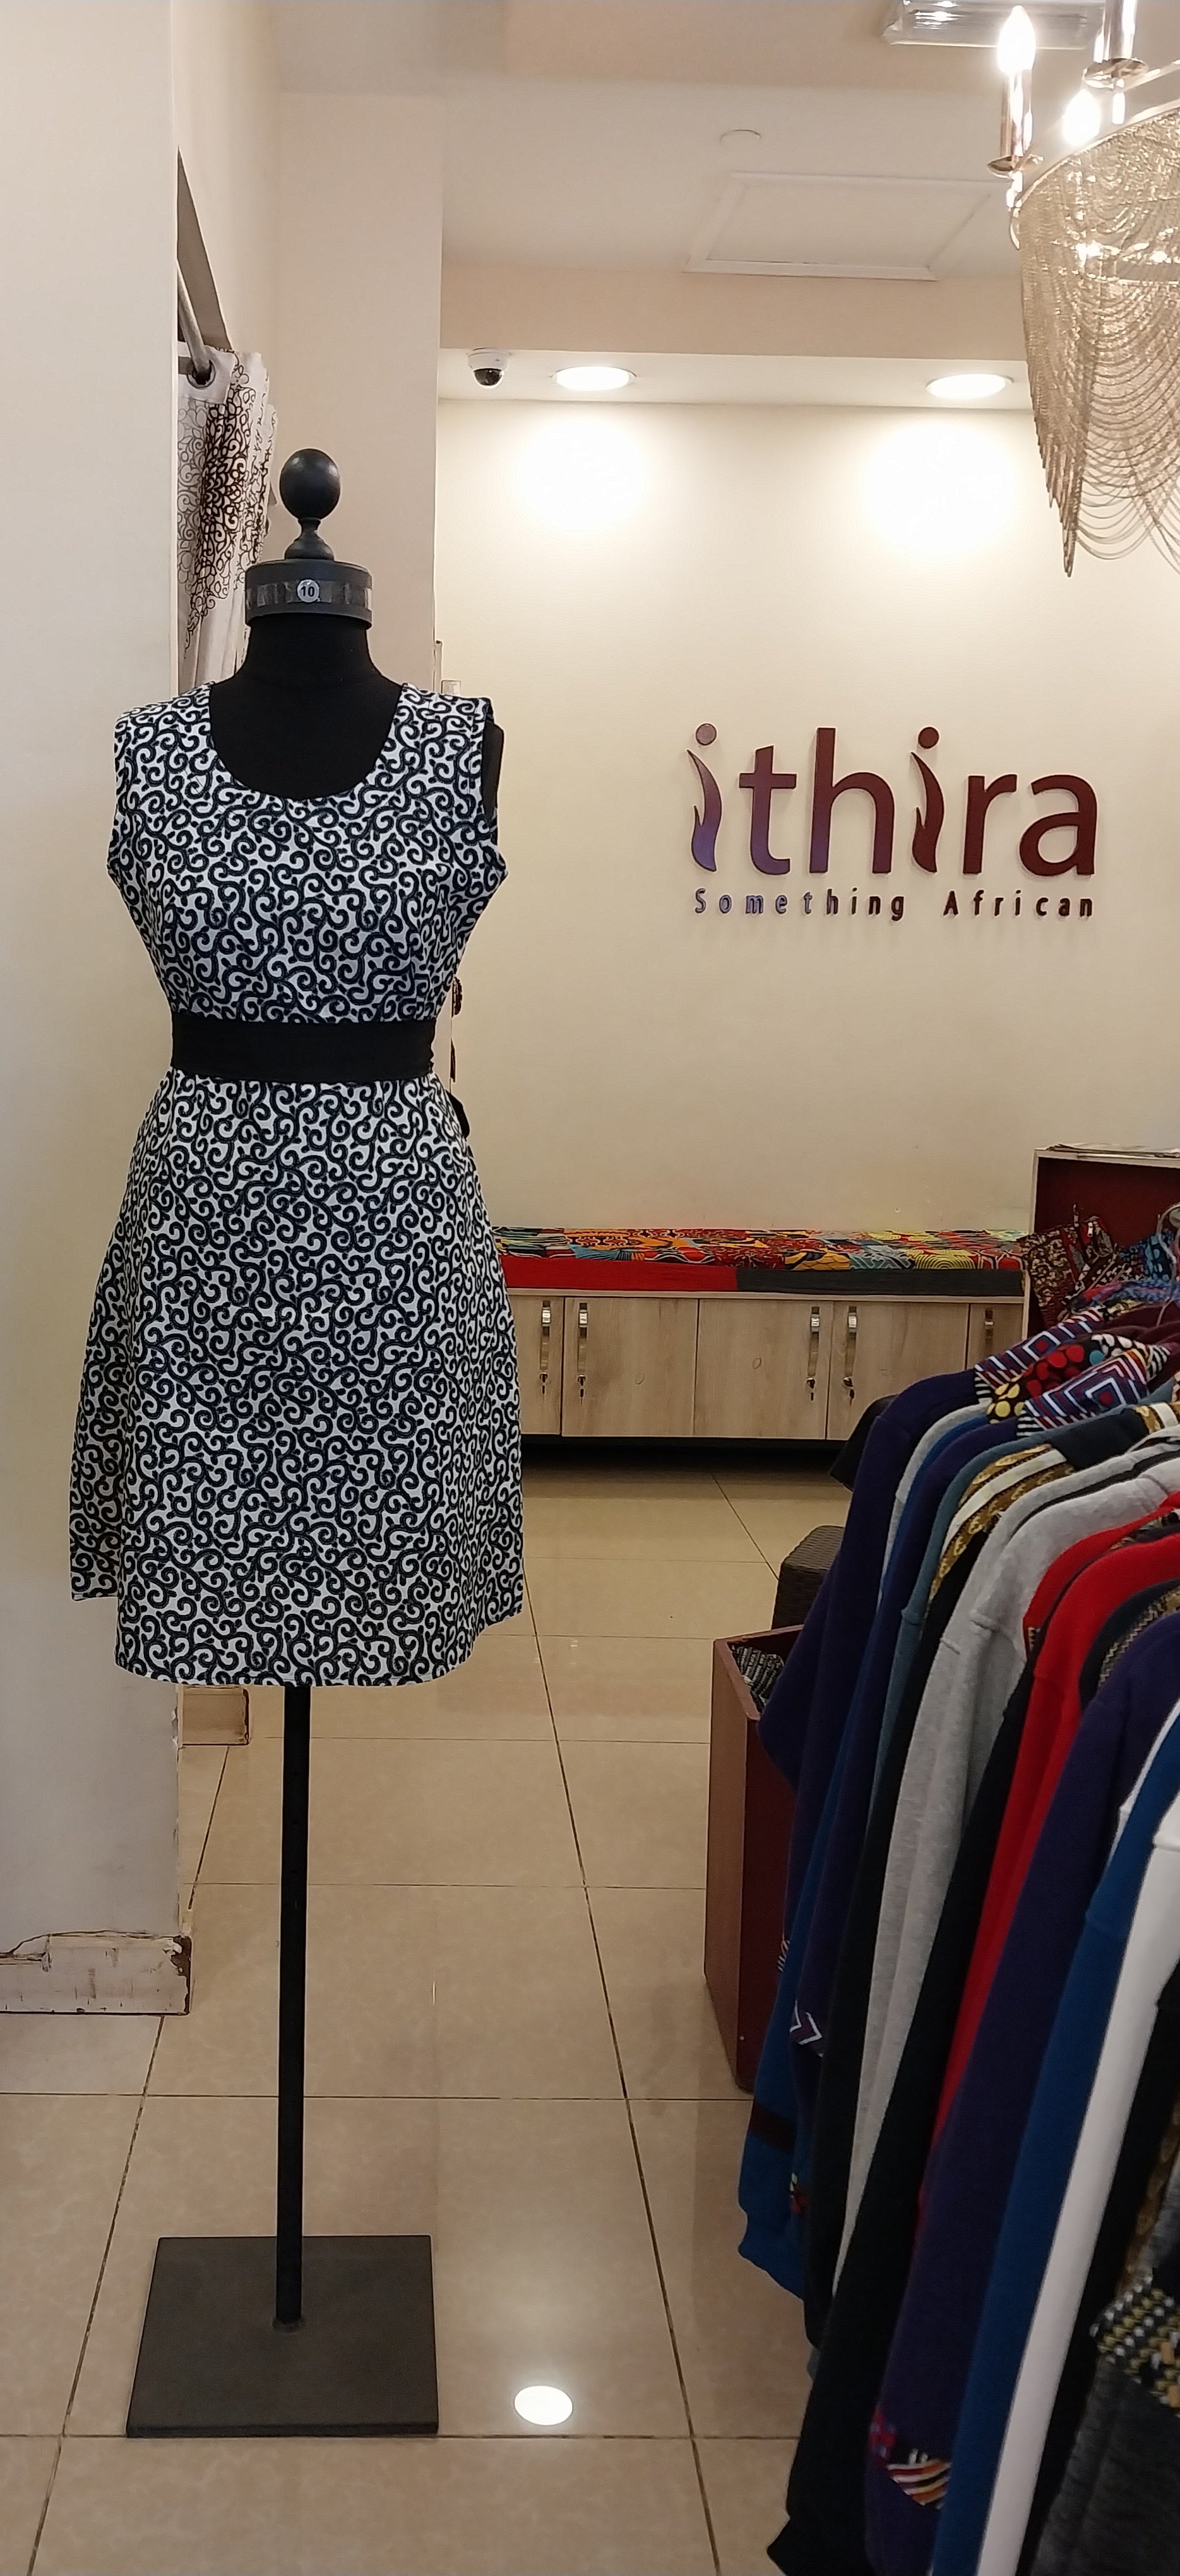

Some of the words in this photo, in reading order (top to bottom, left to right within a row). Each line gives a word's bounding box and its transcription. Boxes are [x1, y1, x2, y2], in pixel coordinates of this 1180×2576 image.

[301, 586, 316, 597] 10
[687, 723, 1097, 876] ithira
[694, 887, 905, 921] Something
[943, 889, 1093, 917] African
